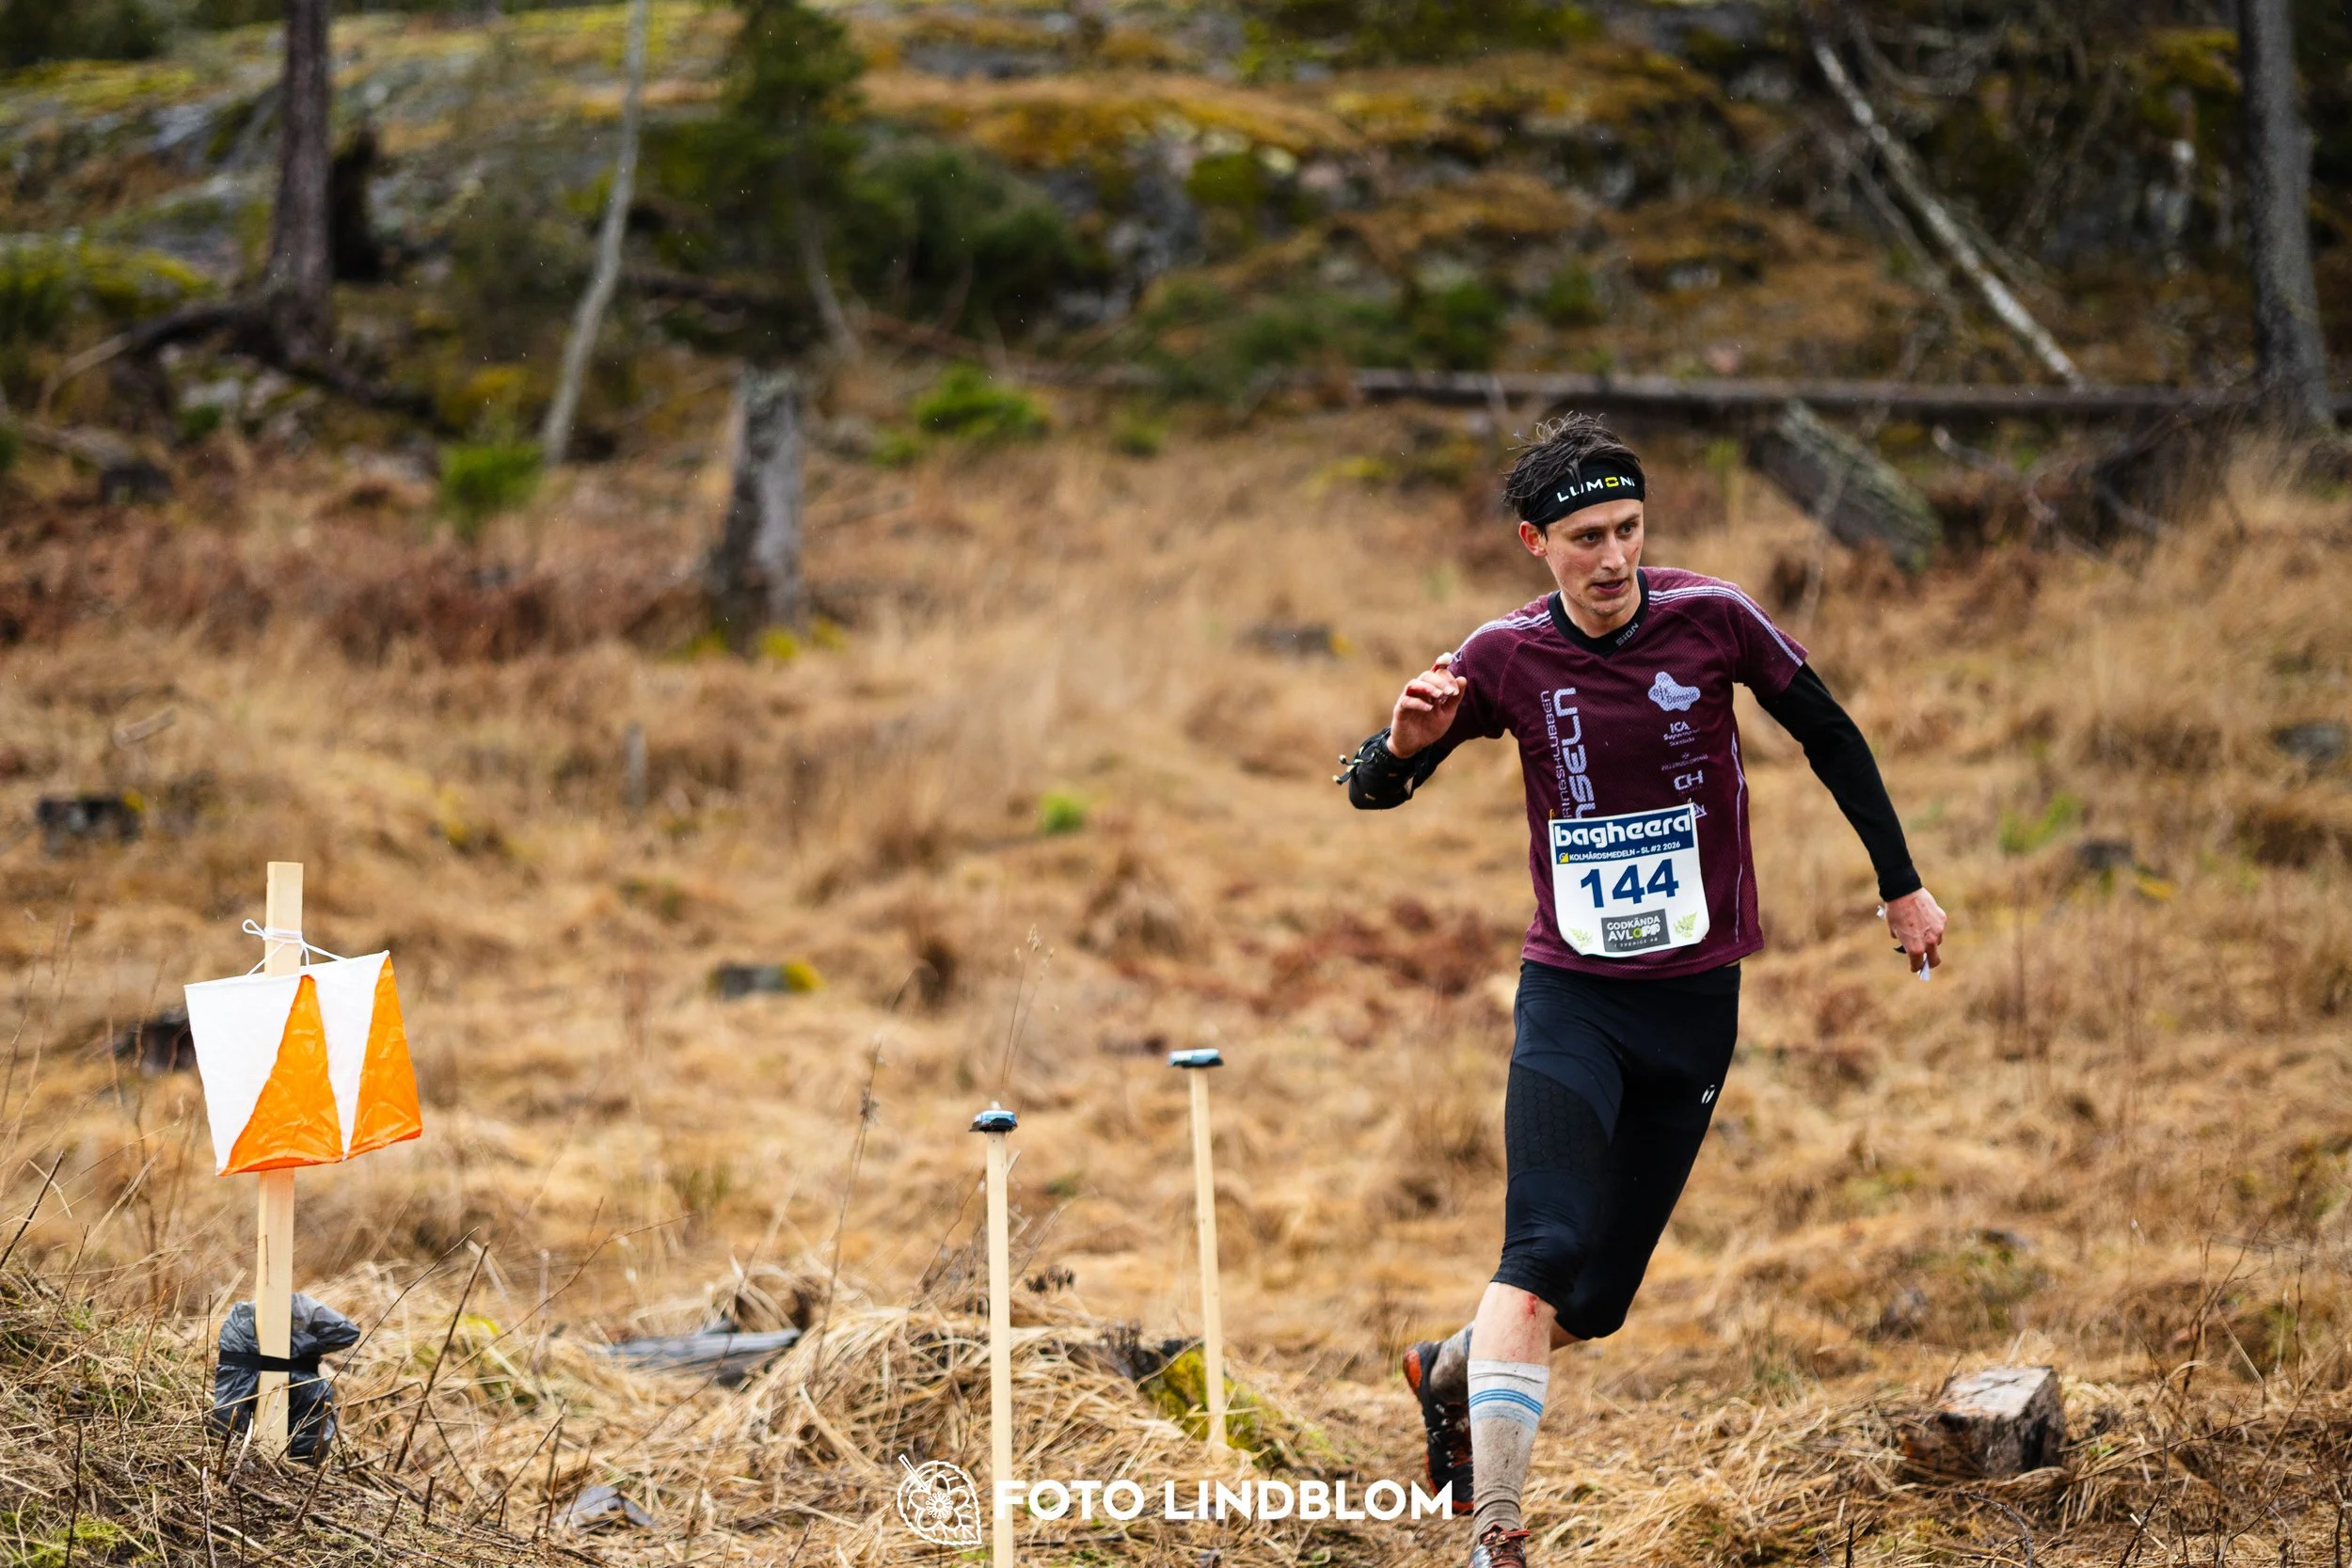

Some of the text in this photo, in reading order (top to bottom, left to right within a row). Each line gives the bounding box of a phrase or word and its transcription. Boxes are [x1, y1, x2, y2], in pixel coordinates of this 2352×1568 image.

[1670, 721, 1691, 734] ICA
[1674, 769, 1704, 790] CH
[1555, 813, 1691, 848] bagheera
[1663, 841, 1680, 850] 2026
[1581, 858, 1679, 908] 144
[1607, 915, 1661, 930] GODKÄNDA
[1608, 924, 1661, 942] AVLOPP
